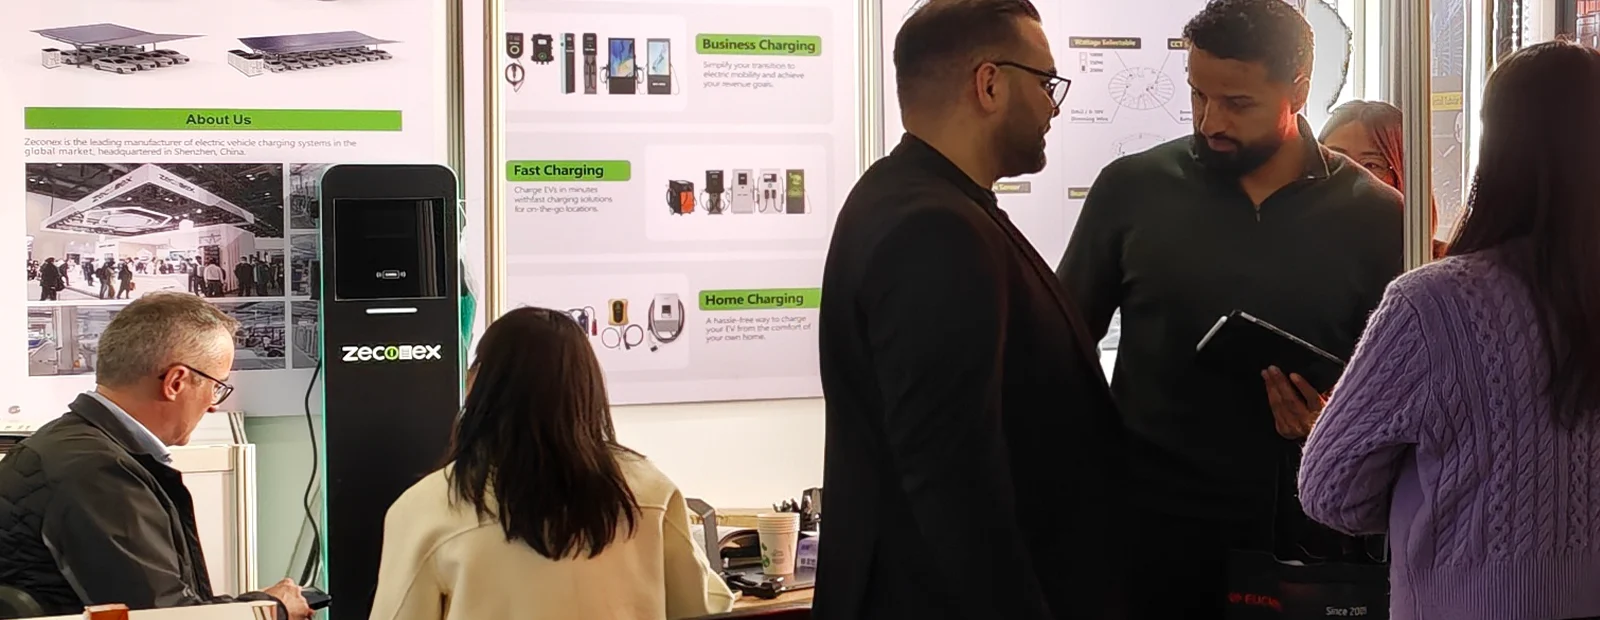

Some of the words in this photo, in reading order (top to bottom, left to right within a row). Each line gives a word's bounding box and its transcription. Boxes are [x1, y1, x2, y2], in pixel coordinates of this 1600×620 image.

[702, 38, 756, 50] Business
[759, 39, 816, 54] Charging
[703, 61, 732, 71] Simplify
[733, 63, 750, 71] your
[752, 62, 786, 70] transition
[703, 71, 730, 79] electric
[731, 71, 761, 80] mobility
[762, 71, 776, 79] and
[703, 81, 720, 89] your
[186, 114, 230, 125] About
[233, 114, 252, 125] Us
[24, 138, 62, 147] Zeconex
[64, 138, 71, 146] is
[73, 138, 88, 146] the
[90, 138, 122, 148] leading
[124, 138, 182, 147] manufacturer
[184, 138, 193, 147] of
[194, 139, 225, 147] electric
[227, 139, 256, 147] vehicle
[258, 139, 296, 149] charging
[297, 140, 332, 149] systems
[343, 140, 357, 148] the
[24, 147, 56, 157] global
[58, 147, 96, 157] market,
[97, 147, 162, 157] headquartered
[164, 147, 172, 156] in
[174, 147, 218, 157] Shenzhen,
[220, 148, 246, 156] China.
[514, 165, 541, 176] Fast
[544, 164, 604, 178] Charging
[514, 186, 542, 195] Charge
[544, 186, 557, 194] EVs
[559, 186, 567, 194] in
[568, 186, 598, 194] minutes
[547, 195, 579, 205] charging
[580, 195, 613, 203] solutions
[514, 205, 525, 213] for
[526, 205, 564, 214] on-the-go
[565, 205, 599, 213] locations.
[705, 294, 745, 306] Home
[747, 292, 804, 307] Charging
[706, 317, 712, 325] A
[713, 316, 754, 325] hassle-free
[755, 317, 771, 325] way
[781, 315, 807, 324] charge
[706, 327, 723, 335] your
[725, 325, 735, 333] EV
[736, 324, 756, 333] from
[757, 324, 770, 332] the
[771, 323, 801, 332] comfort
[802, 323, 812, 331] of
[706, 335, 723, 344] your
[724, 334, 741, 342] own
[742, 333, 766, 342] home.
[1325, 606, 1348, 616] Since
